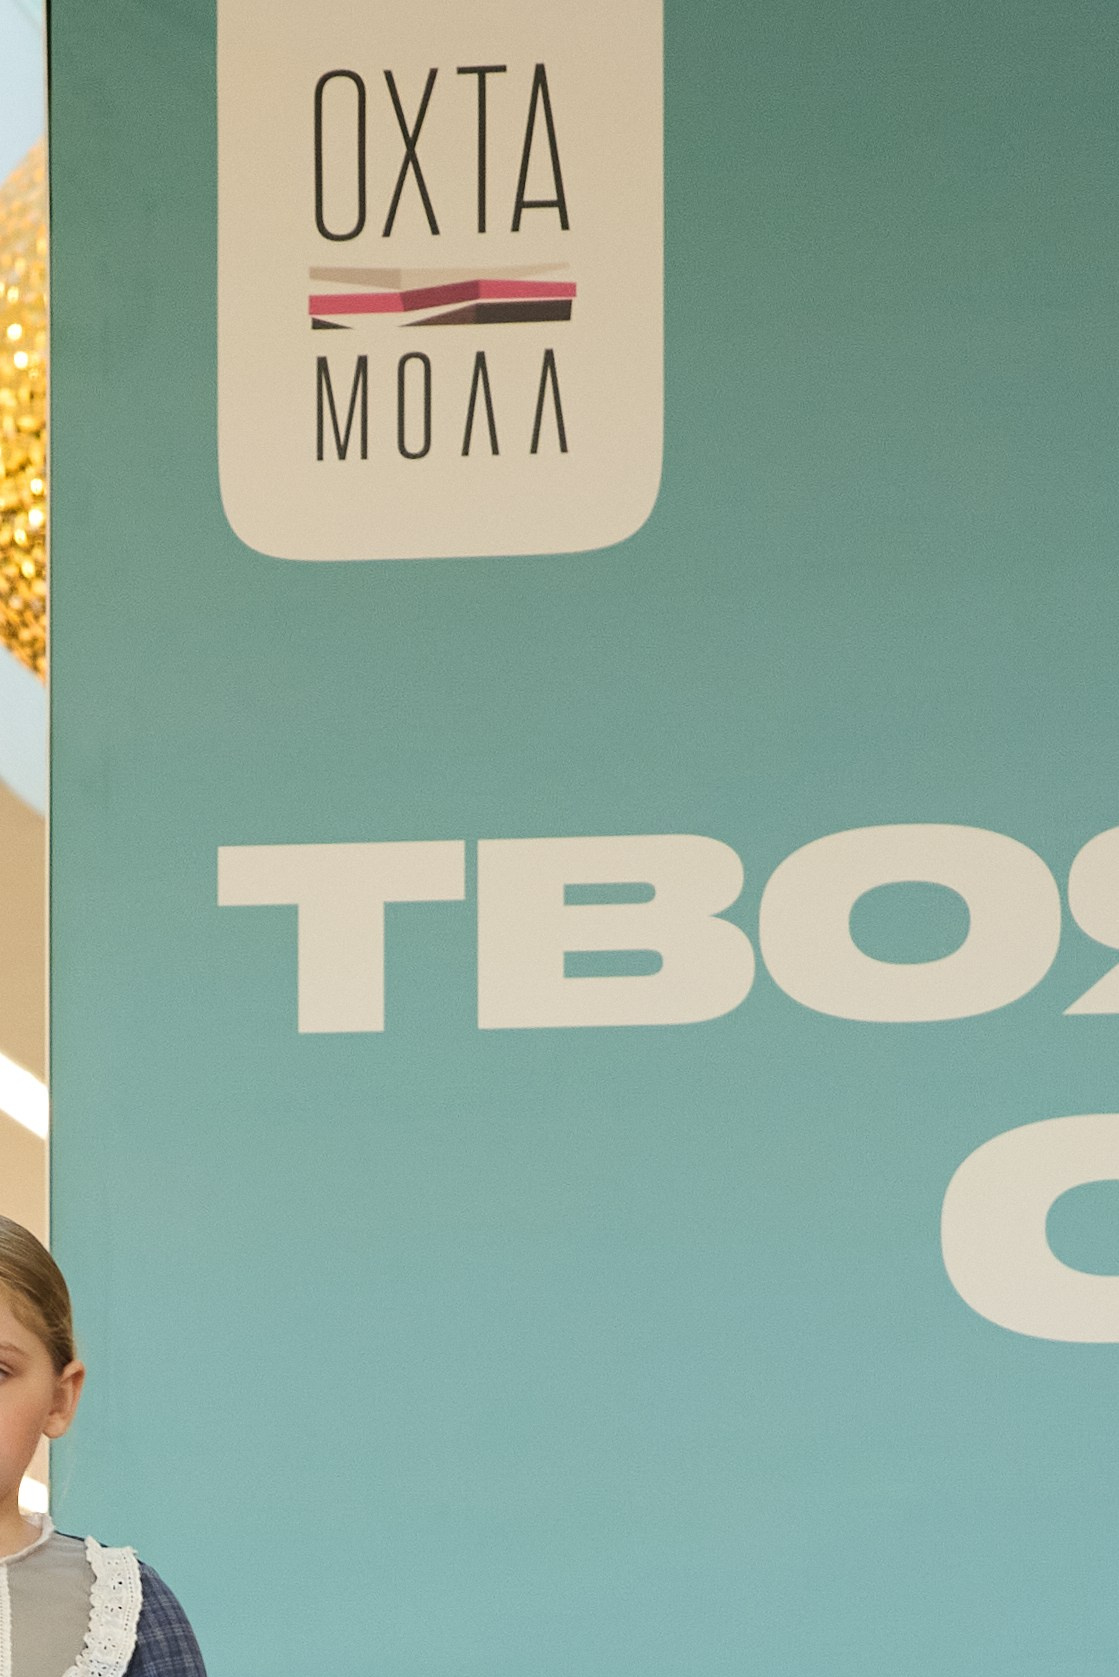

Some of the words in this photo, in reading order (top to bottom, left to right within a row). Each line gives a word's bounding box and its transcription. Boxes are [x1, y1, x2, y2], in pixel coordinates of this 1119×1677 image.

[313, 62, 571, 242] ОХТА
[314, 348, 569, 462] МОЛЛ
[217, 823, 1119, 1034] ТВО
